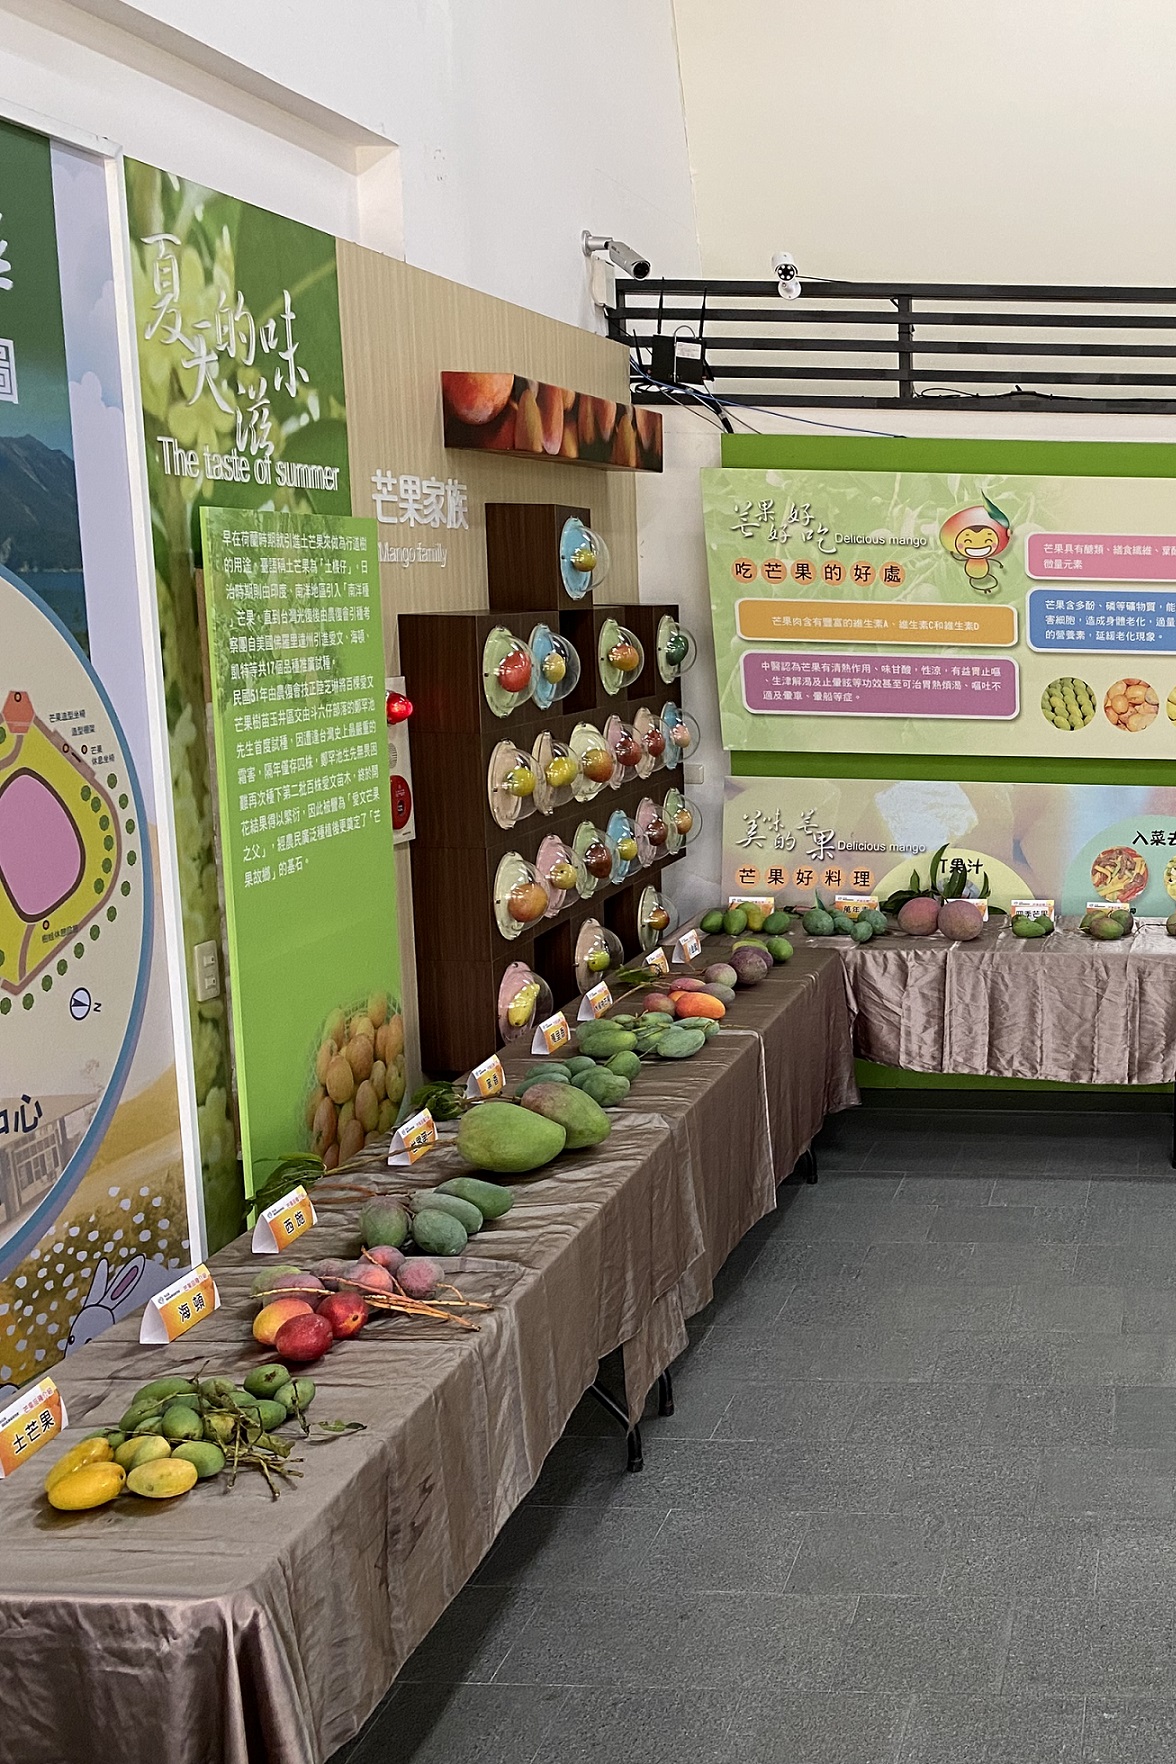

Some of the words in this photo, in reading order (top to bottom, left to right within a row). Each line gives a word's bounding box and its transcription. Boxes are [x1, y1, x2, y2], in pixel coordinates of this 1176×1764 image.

[157, 436, 199, 476] The
[202, 445, 250, 482] taste
[254, 453, 272, 484] of
[275, 459, 339, 491] summer
[371, 468, 469, 530] 芒果家族
[834, 532, 886, 545] Delicious
[888, 535, 928, 548] mango
[378, 542, 416, 567] Mango
[416, 542, 447, 567] family
[1043, 559, 1083, 570] 微量元素
[735, 563, 901, 583] 吃芒果的好處
[838, 841, 887, 852] Delicious
[889, 843, 926, 853] mango
[739, 869, 871, 887] 芒果好料理
[13, 1409, 55, 1454] 土芒果
